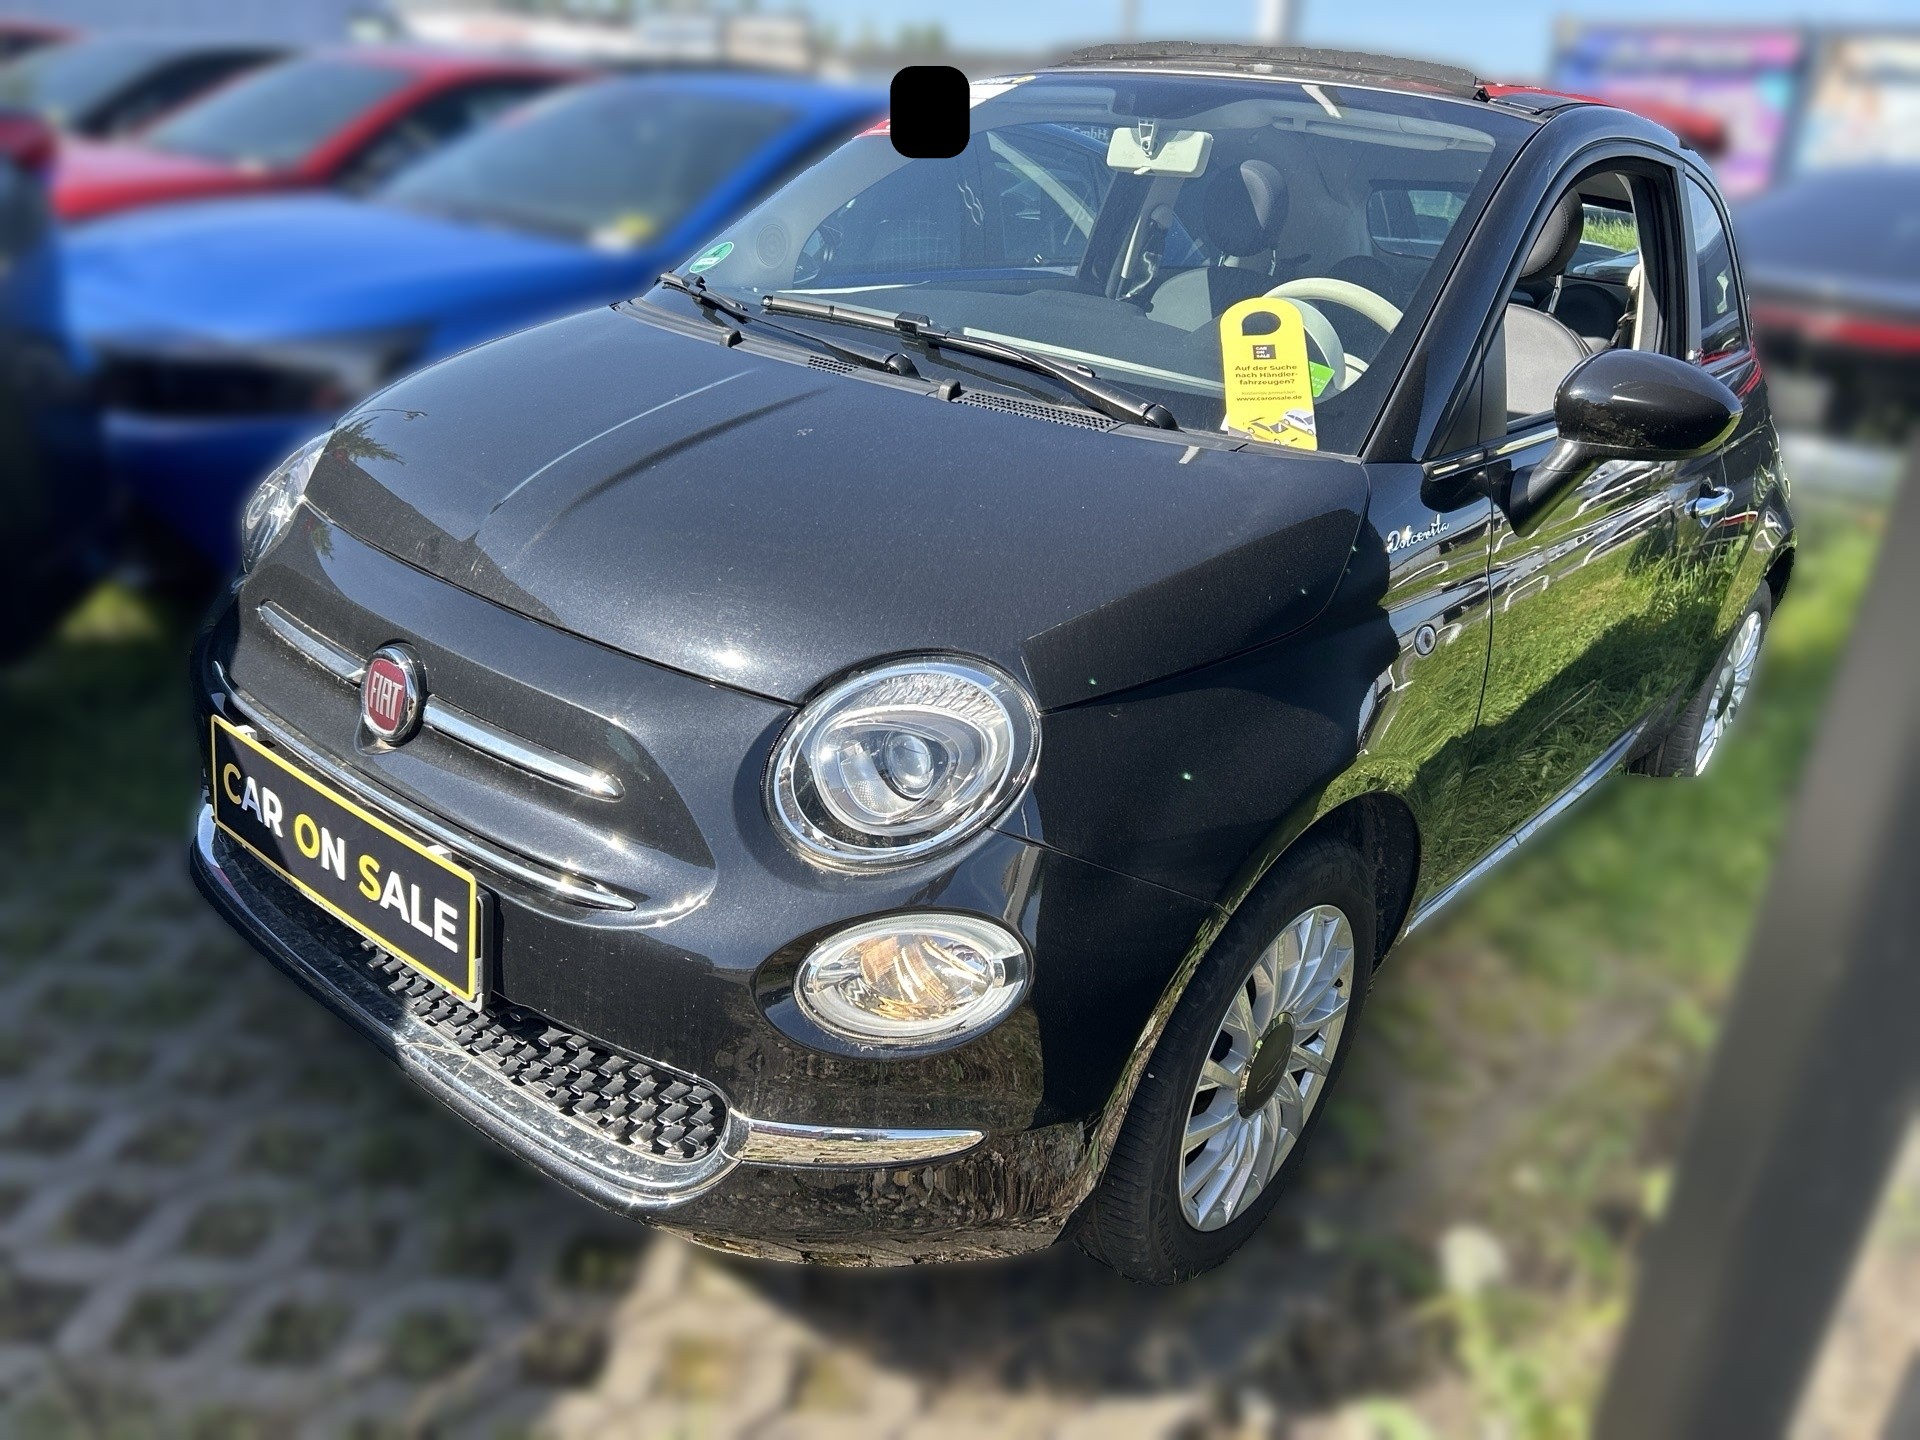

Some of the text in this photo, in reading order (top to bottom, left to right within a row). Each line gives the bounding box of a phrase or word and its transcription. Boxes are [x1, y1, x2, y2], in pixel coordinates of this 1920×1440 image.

[1239, 378, 1295, 386] fahrzeugen?
[369, 670, 404, 721] FIAT
[223, 762, 283, 838] CAR
[294, 813, 346, 882] ON
[357, 854, 458, 954] SALE
